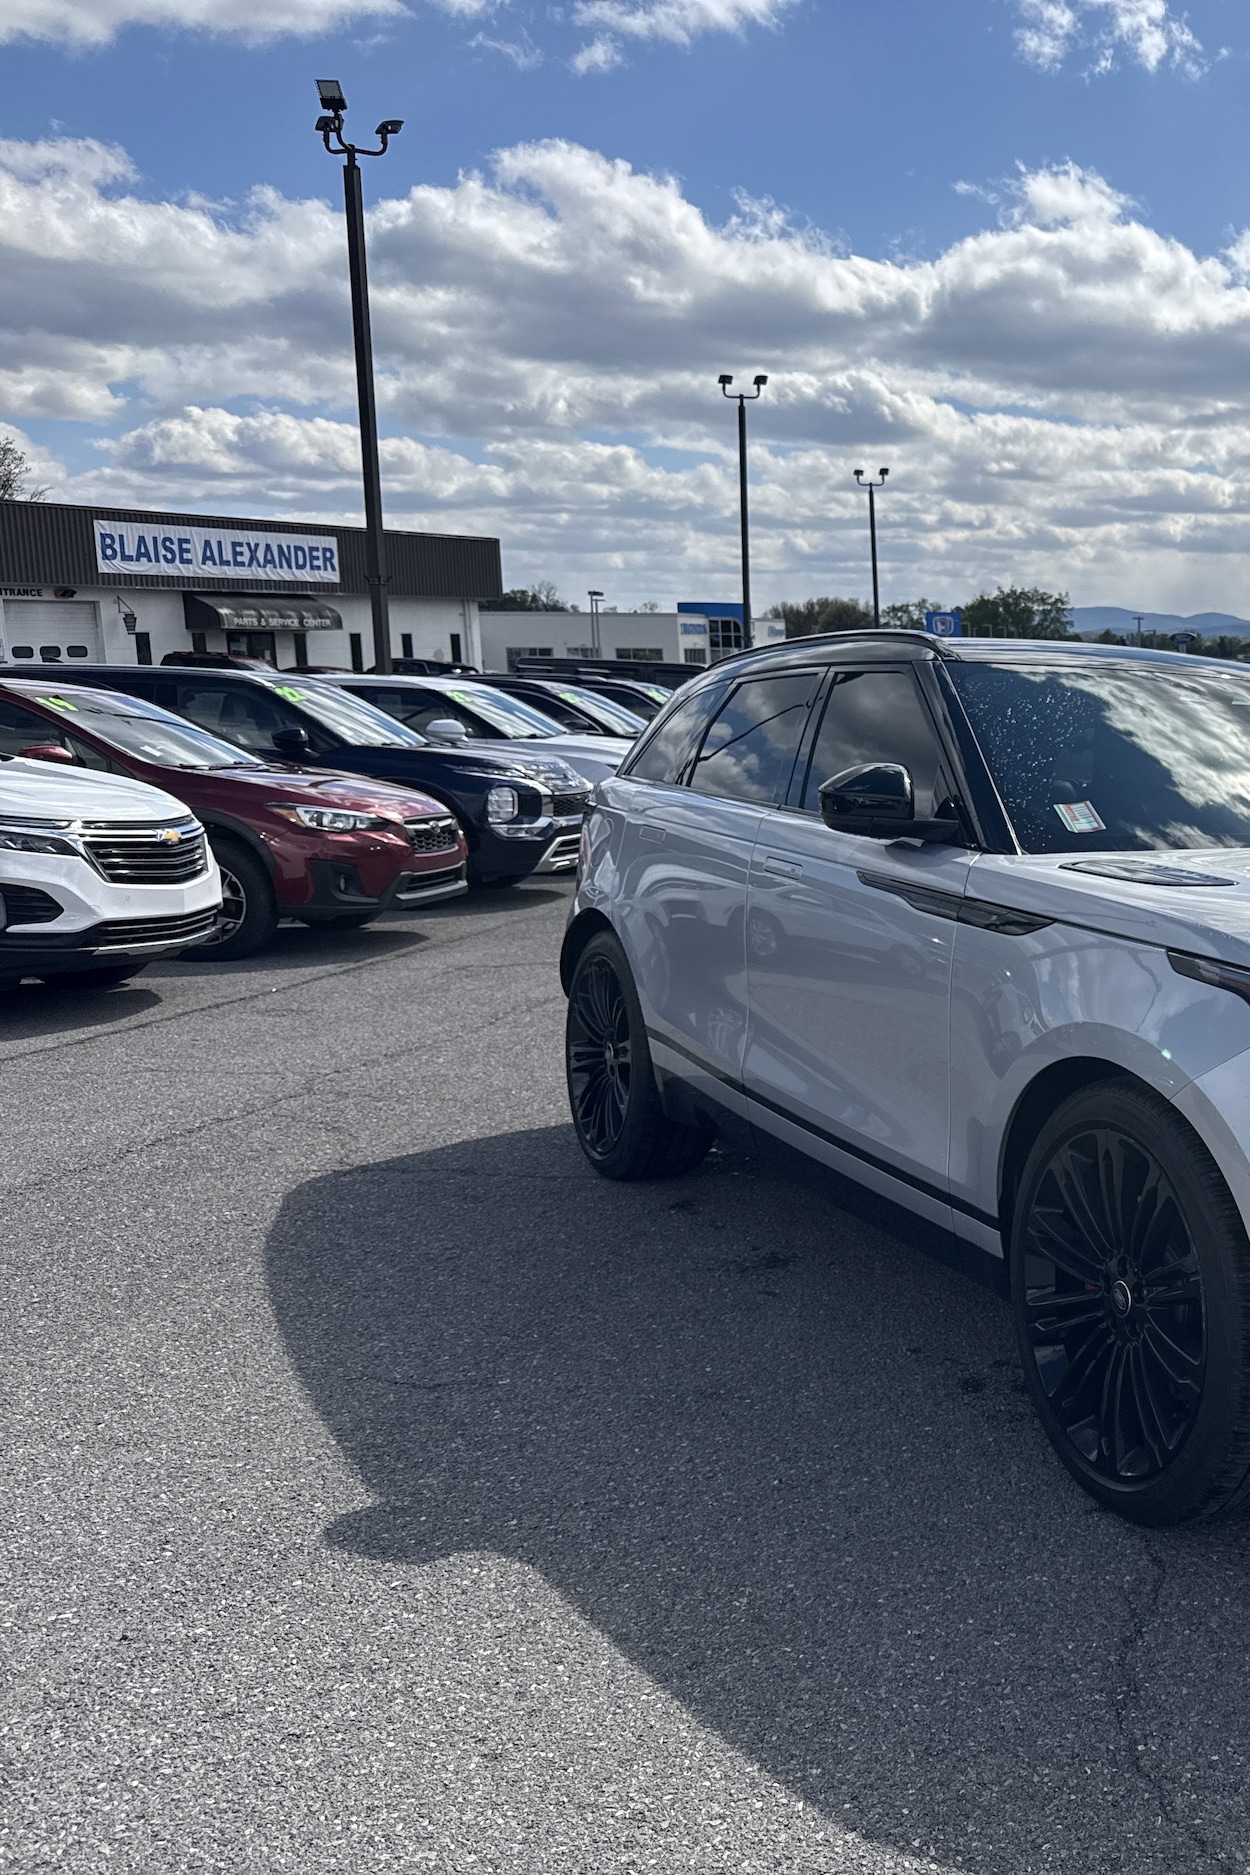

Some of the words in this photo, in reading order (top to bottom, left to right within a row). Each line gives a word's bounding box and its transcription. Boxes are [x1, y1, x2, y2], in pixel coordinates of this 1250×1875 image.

[99, 532, 193, 565] BLAISE
[201, 539, 337, 572] ALEXANDER
[233, 617, 258, 627] PARTS
[260, 618, 266, 627] &
[268, 618, 300, 628] SERVICE
[303, 619, 332, 628] CENTER
